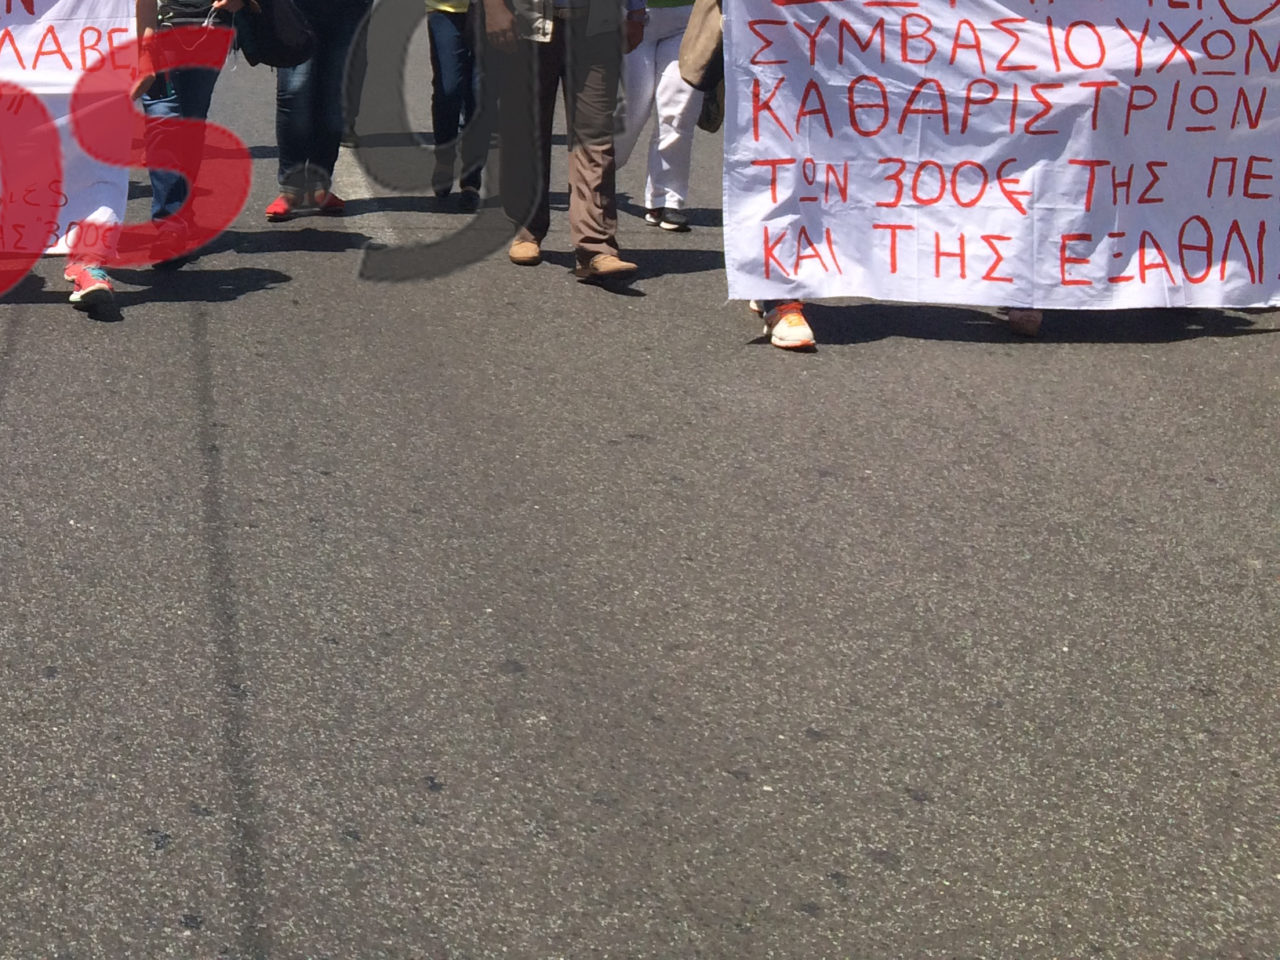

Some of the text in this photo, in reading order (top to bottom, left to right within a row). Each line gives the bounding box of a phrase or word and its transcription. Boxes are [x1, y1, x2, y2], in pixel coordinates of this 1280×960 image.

[750, 74, 1267, 142] ΚΑΘΑΡΙΣΤΡΙΩΝ
[750, 157, 849, 204] ΤΩΝ
[1068, 158, 1168, 213] ΤΗΣ
[1207, 155, 1280, 199] ΠΕ
[763, 214, 1280, 286] ΚΑΙ ΤΗΣ ΕΞΑΘΛΙ
